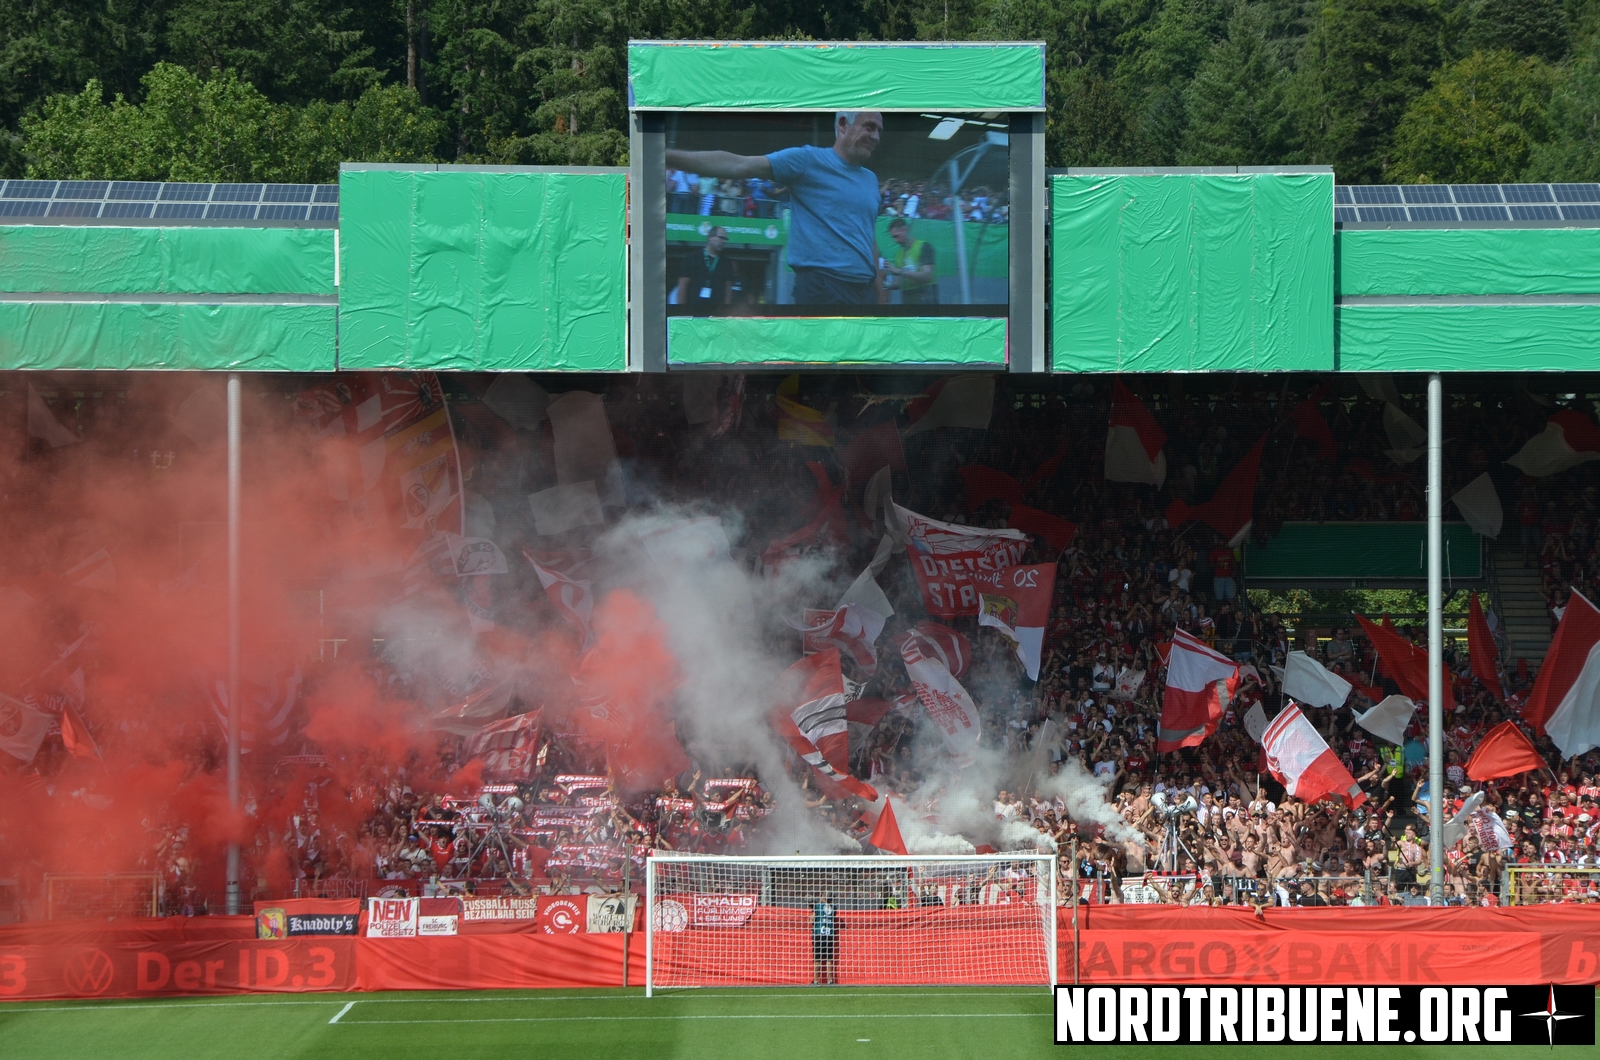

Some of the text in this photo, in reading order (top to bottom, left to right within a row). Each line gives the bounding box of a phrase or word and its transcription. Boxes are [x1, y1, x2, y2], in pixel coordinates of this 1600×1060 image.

[464, 898, 536, 910] FUSSBALL MUSS
[697, 897, 753, 906] KHALID
[373, 899, 412, 922] NEIN
[543, 900, 580, 916] VIDEOBEWEIS
[720, 907, 753, 915] IMMER
[464, 909, 535, 920] BEZAHLBAR SEIN
[290, 915, 353, 933] Knaddly's
[381, 928, 414, 936] GESETZ
[137, 947, 336, 991] Der ID.3
